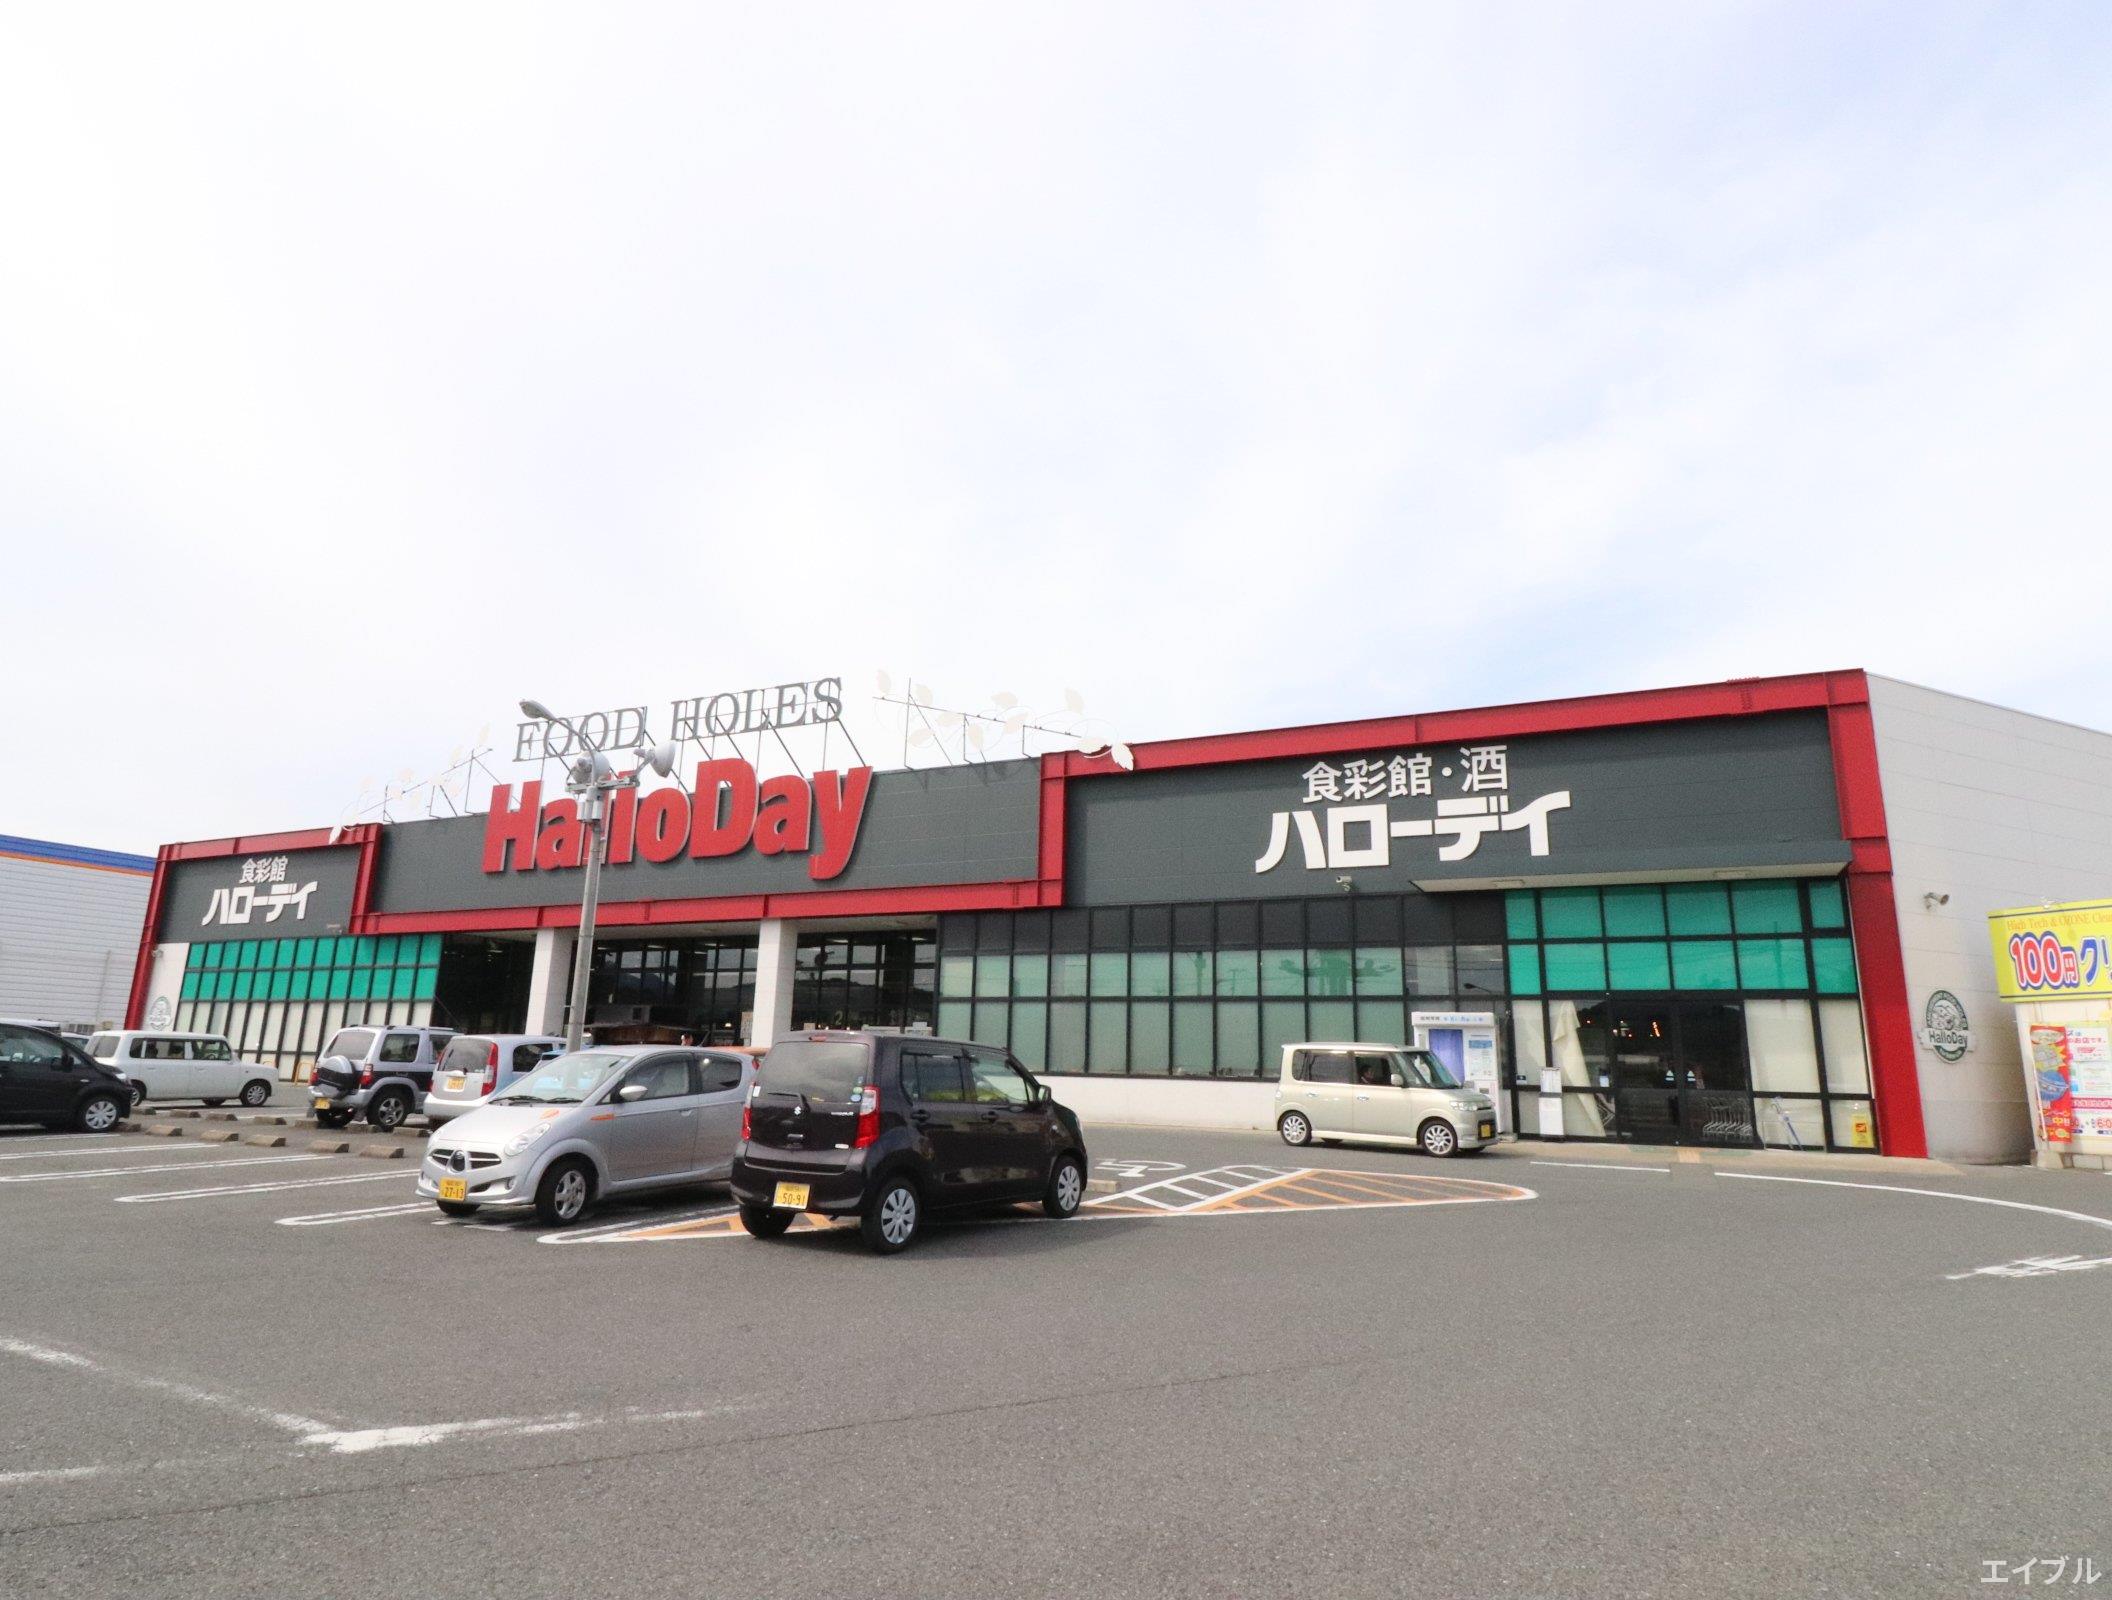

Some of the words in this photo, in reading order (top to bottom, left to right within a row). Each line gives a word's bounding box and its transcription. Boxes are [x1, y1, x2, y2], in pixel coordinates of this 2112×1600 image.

[512, 706, 647, 762] FOOD
[670, 677, 843, 742] HOLES
[1302, 745, 1508, 804] 食彩館・酒
[1255, 790, 1571, 874] ハローデイ
[239, 856, 289, 884] 食彩館
[201, 881, 318, 926] ハローデイ
[1928, 1029, 1968, 1048] HalloDay
